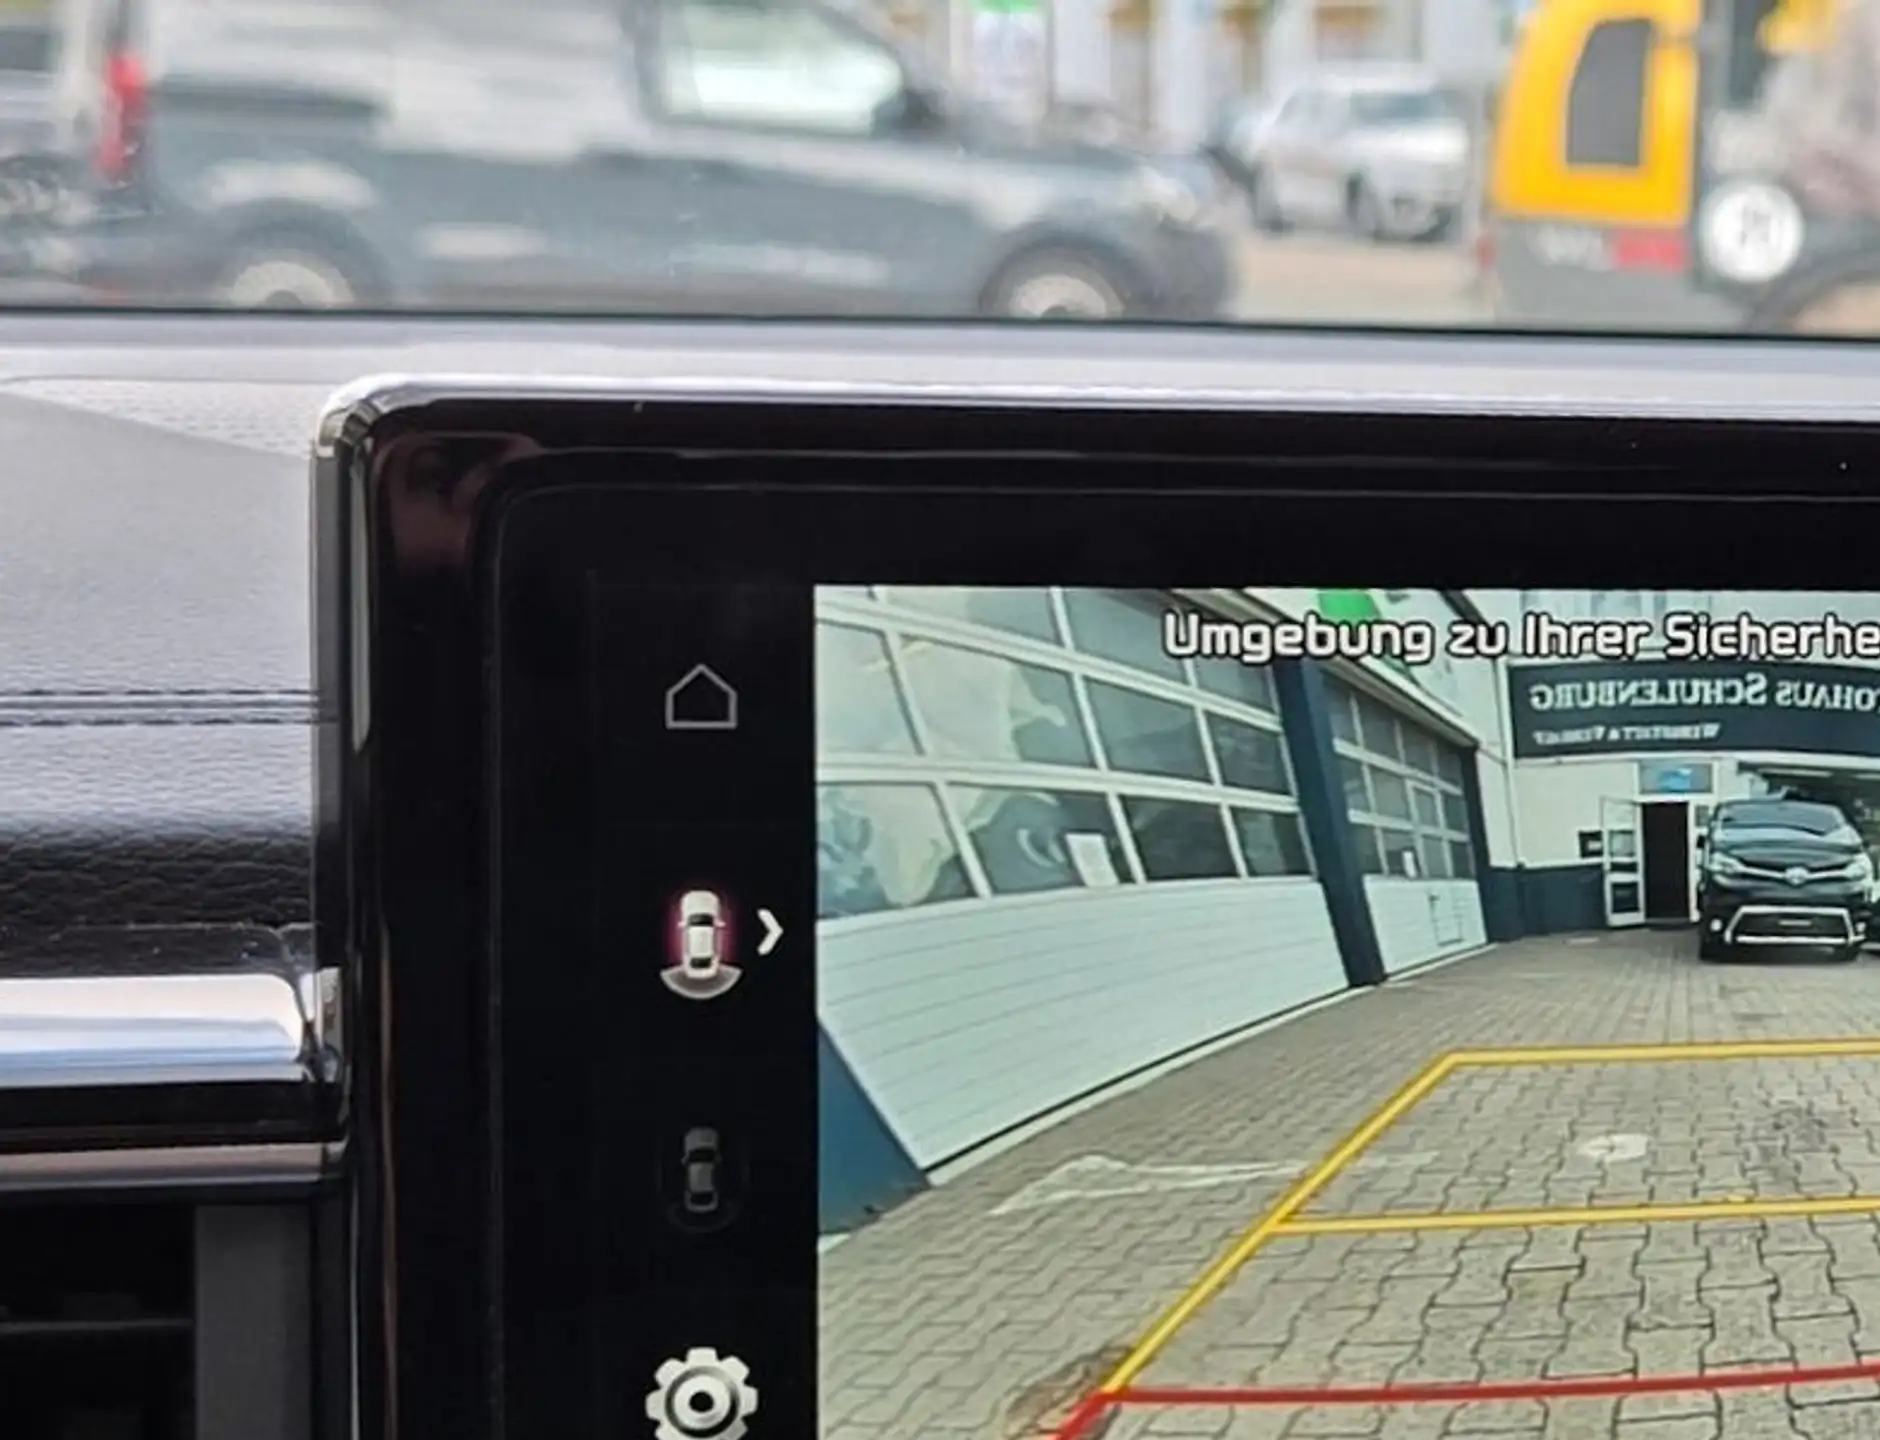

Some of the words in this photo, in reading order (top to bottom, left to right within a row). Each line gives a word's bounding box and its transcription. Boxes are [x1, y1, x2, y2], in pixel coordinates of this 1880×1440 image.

[1164, 611, 1433, 665] Umgebung
[1444, 620, 1509, 657] zu
[1524, 611, 1651, 657] Ihrer
